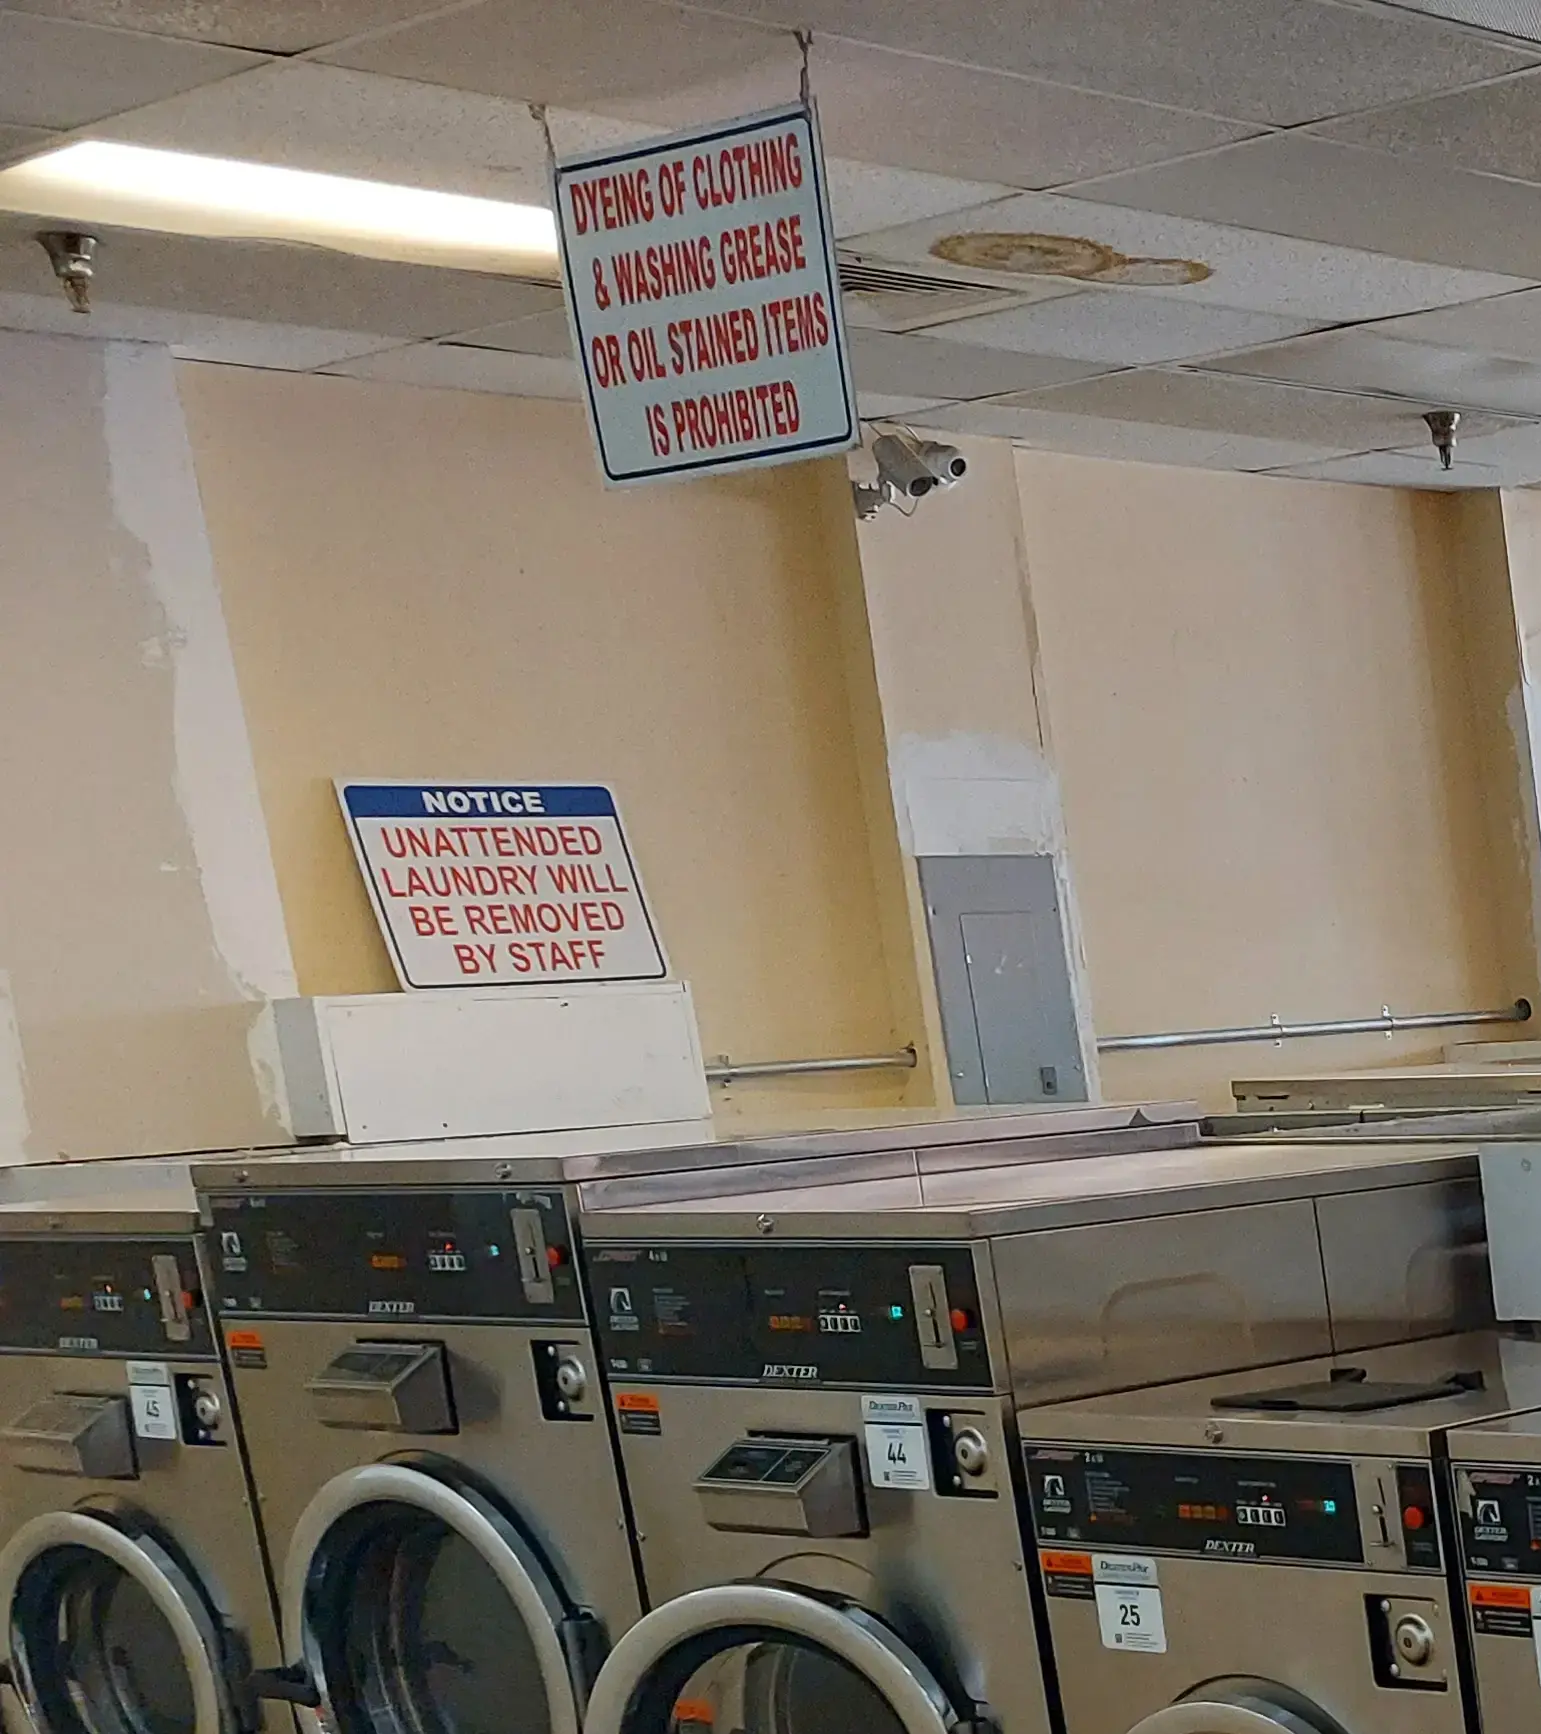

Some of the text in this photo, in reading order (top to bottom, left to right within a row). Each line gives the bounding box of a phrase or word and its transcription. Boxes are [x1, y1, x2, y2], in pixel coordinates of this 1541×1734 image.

[570, 133, 802, 235] DYEING OF CLOTHING
[593, 215, 805, 310] & WASHING GREASE
[592, 292, 829, 388] OR OIL STAINED ITEMS
[646, 380, 799, 456] IS PROHIBITED
[422, 791, 545, 814] NOTICE
[381, 826, 602, 858] UNATTENDED
[381, 863, 629, 897] LAUNDRY WILL
[409, 901, 625, 936] BE REMOVED
[453, 940, 605, 974] BY STAFF
[762, 1364, 818, 1378] DEXTER
[888, 1443, 907, 1465] 44
[1205, 1539, 1255, 1553] DEXTER
[1120, 1604, 1141, 1626] 25
